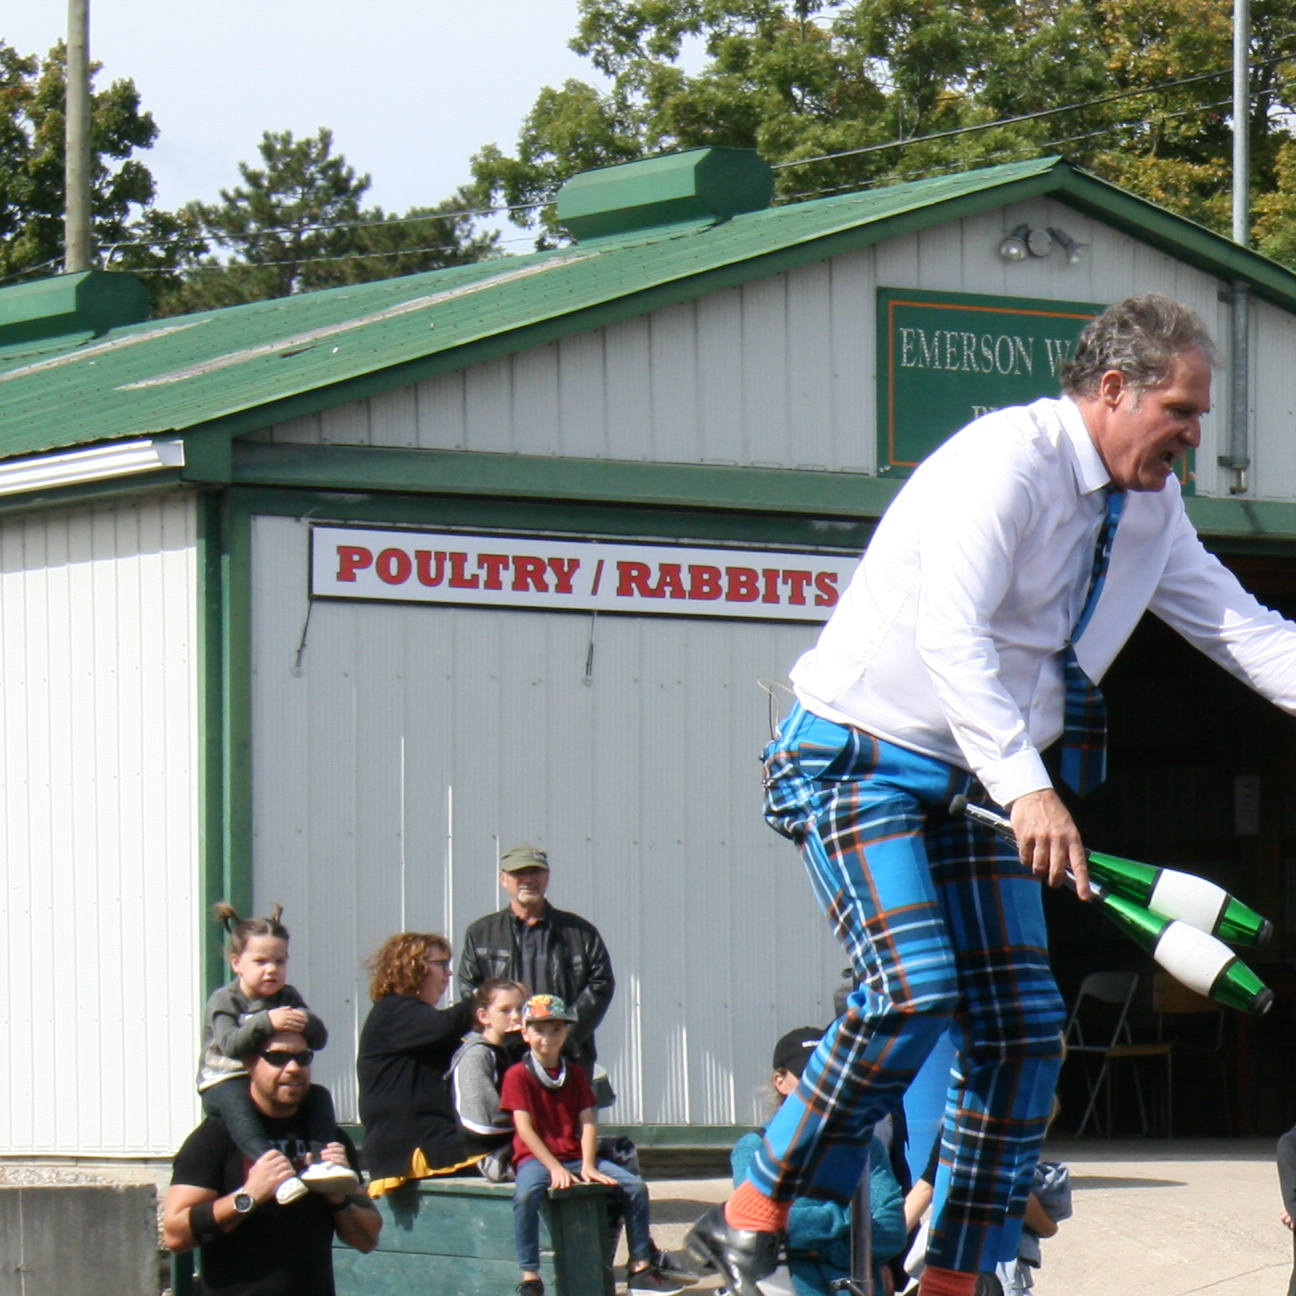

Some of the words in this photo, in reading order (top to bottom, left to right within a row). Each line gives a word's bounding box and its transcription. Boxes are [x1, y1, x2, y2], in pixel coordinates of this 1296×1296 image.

[899, 327, 1033, 376] EMERSON
[336, 545, 580, 595] POULTRY
[616, 561, 839, 608] RABBITS
